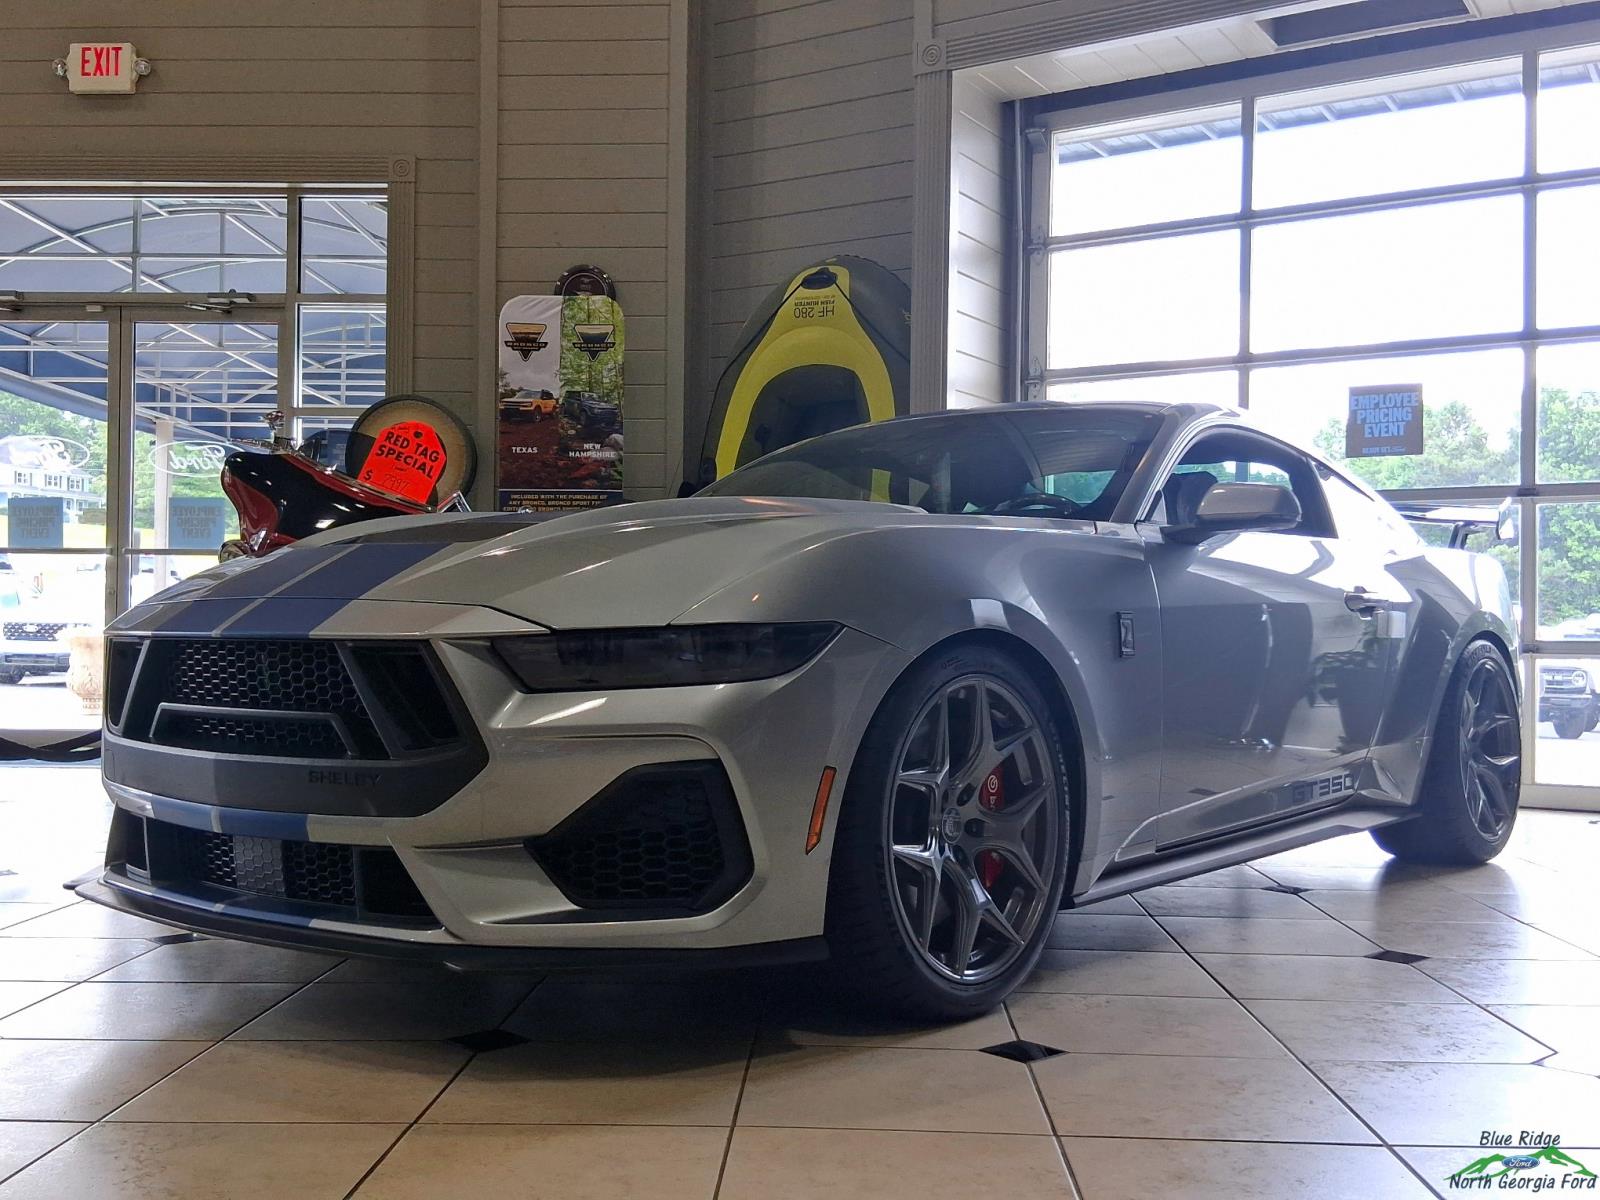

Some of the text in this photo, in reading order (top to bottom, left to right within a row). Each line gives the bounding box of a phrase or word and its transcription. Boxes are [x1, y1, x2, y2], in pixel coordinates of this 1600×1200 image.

[81, 46, 123, 77] EXIT
[793, 304, 835, 319] HF 280
[1351, 391, 1419, 409] EMPLOYEE
[1356, 406, 1412, 425] PRICING
[1364, 421, 1406, 438] EVENT
[384, 431, 440, 463] RED TAG
[376, 444, 434, 479] SPECIAL
[308, 769, 384, 788] SHELBY
[1292, 773, 1355, 803] GT350
